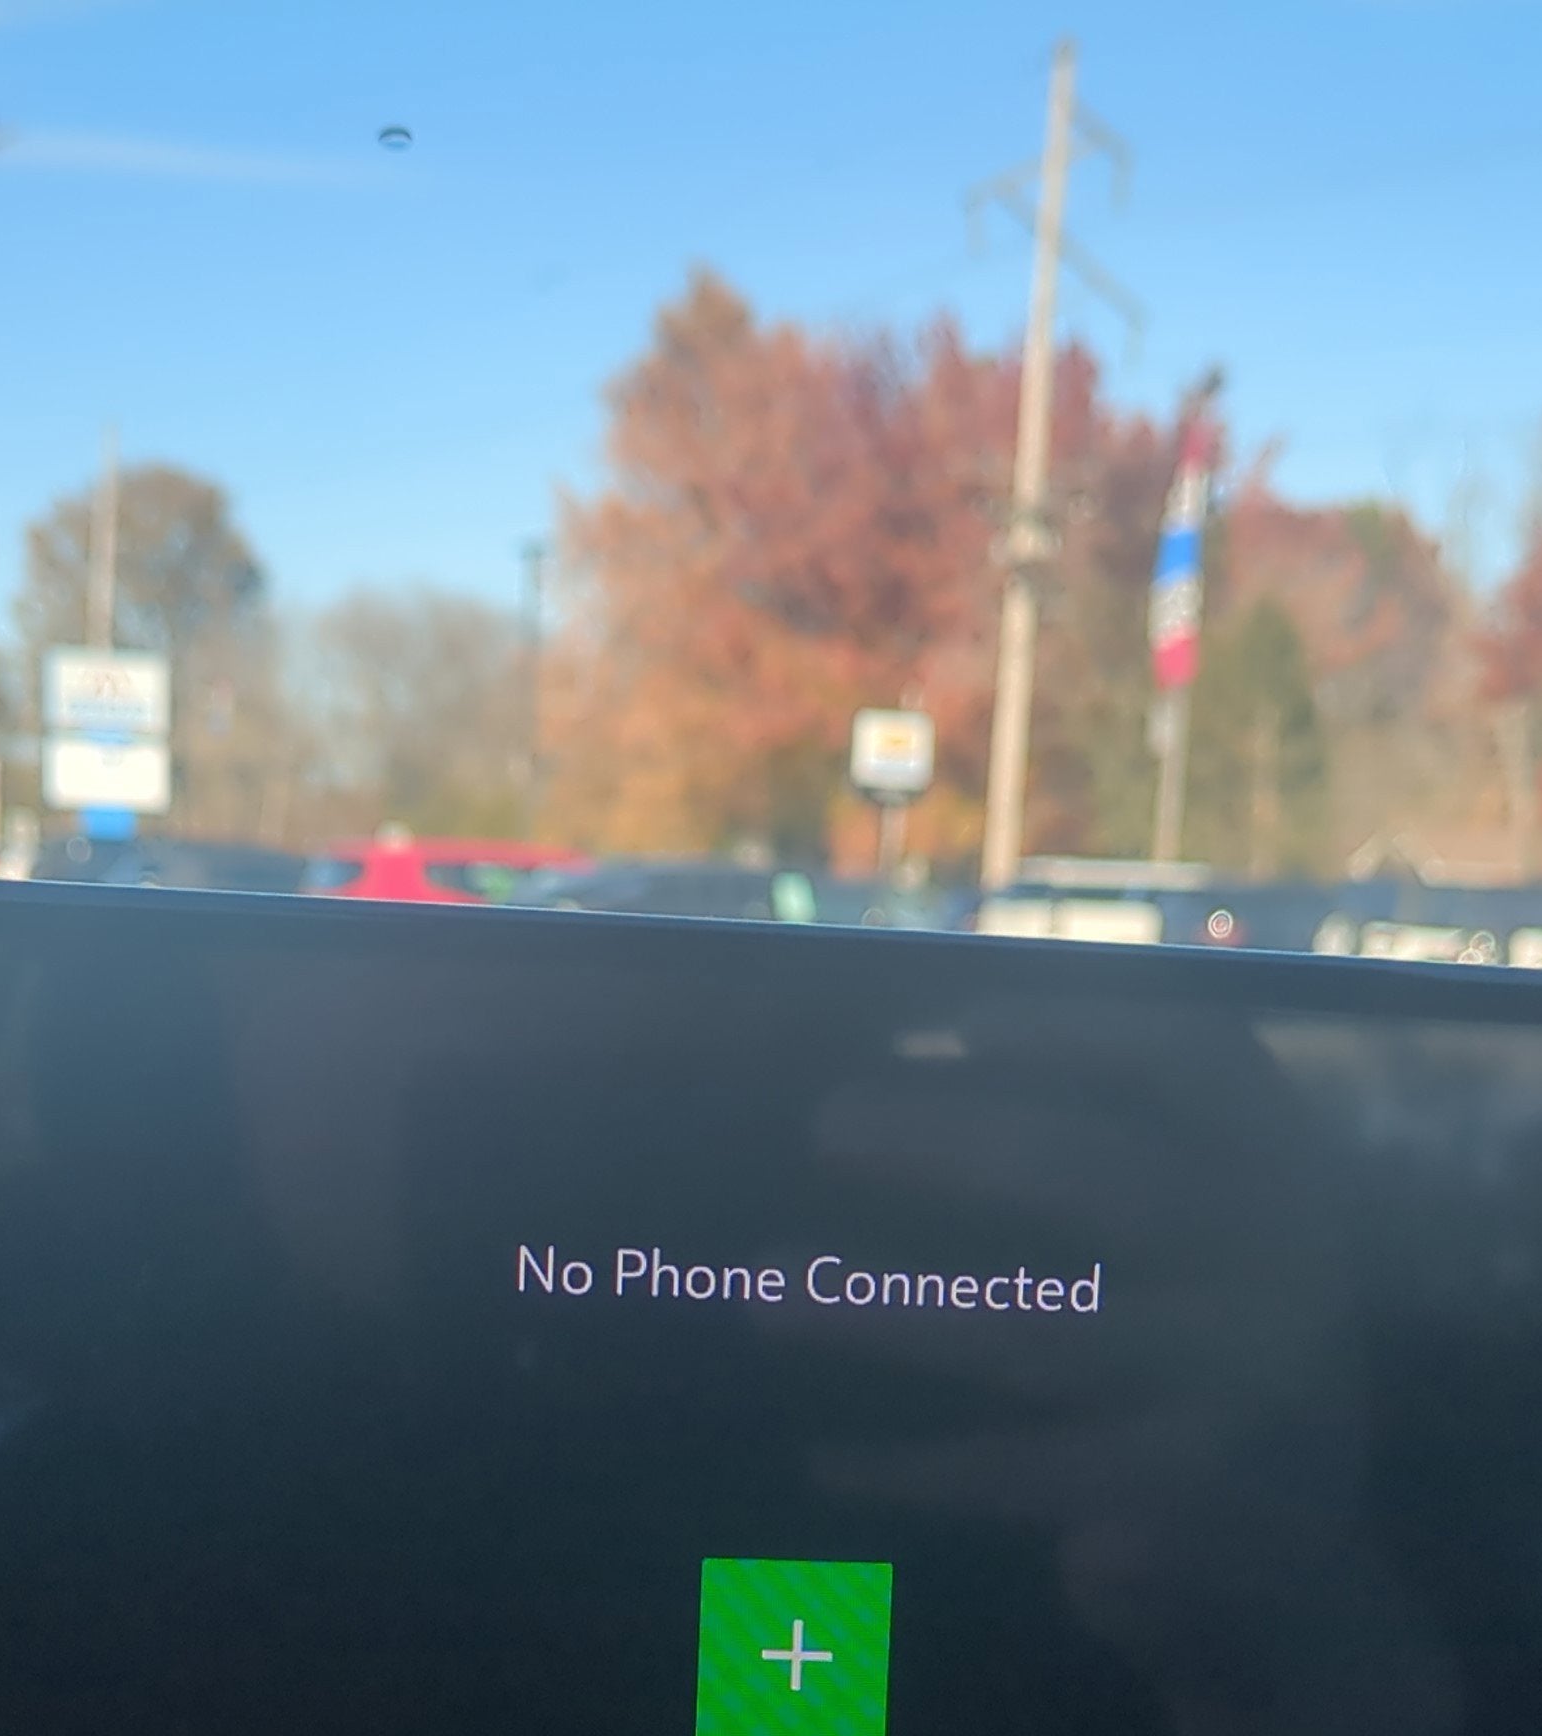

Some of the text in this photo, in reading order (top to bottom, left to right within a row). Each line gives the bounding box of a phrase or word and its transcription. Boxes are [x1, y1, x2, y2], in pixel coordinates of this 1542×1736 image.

[516, 1244, 1102, 1314] No Phone Connected
